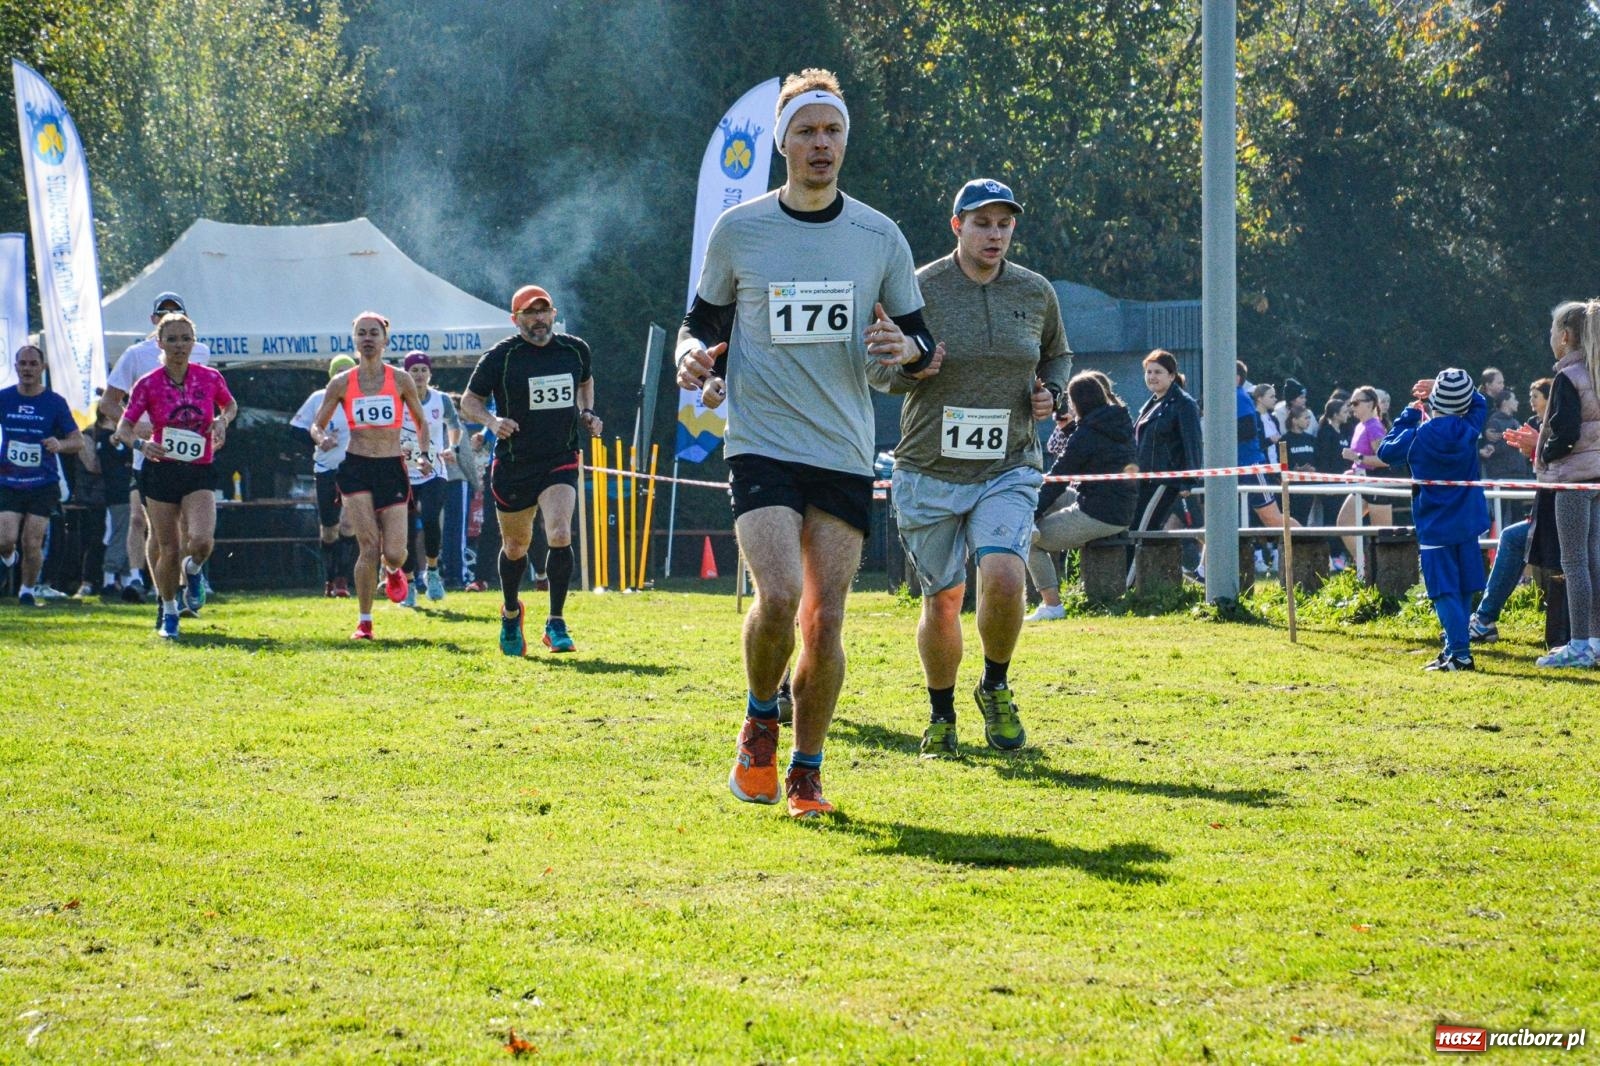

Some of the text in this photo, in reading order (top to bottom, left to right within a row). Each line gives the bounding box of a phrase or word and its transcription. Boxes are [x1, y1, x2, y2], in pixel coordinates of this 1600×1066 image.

[776, 303, 848, 332] 176
[262, 335, 318, 354] AKTYWNI
[330, 335, 354, 353] DLA
[442, 332, 481, 351] JUTRA
[532, 386, 572, 404] 335
[355, 405, 393, 422] 196
[946, 425, 1003, 450] 148
[10, 449, 39, 463] 305
[165, 438, 201, 457] 309
